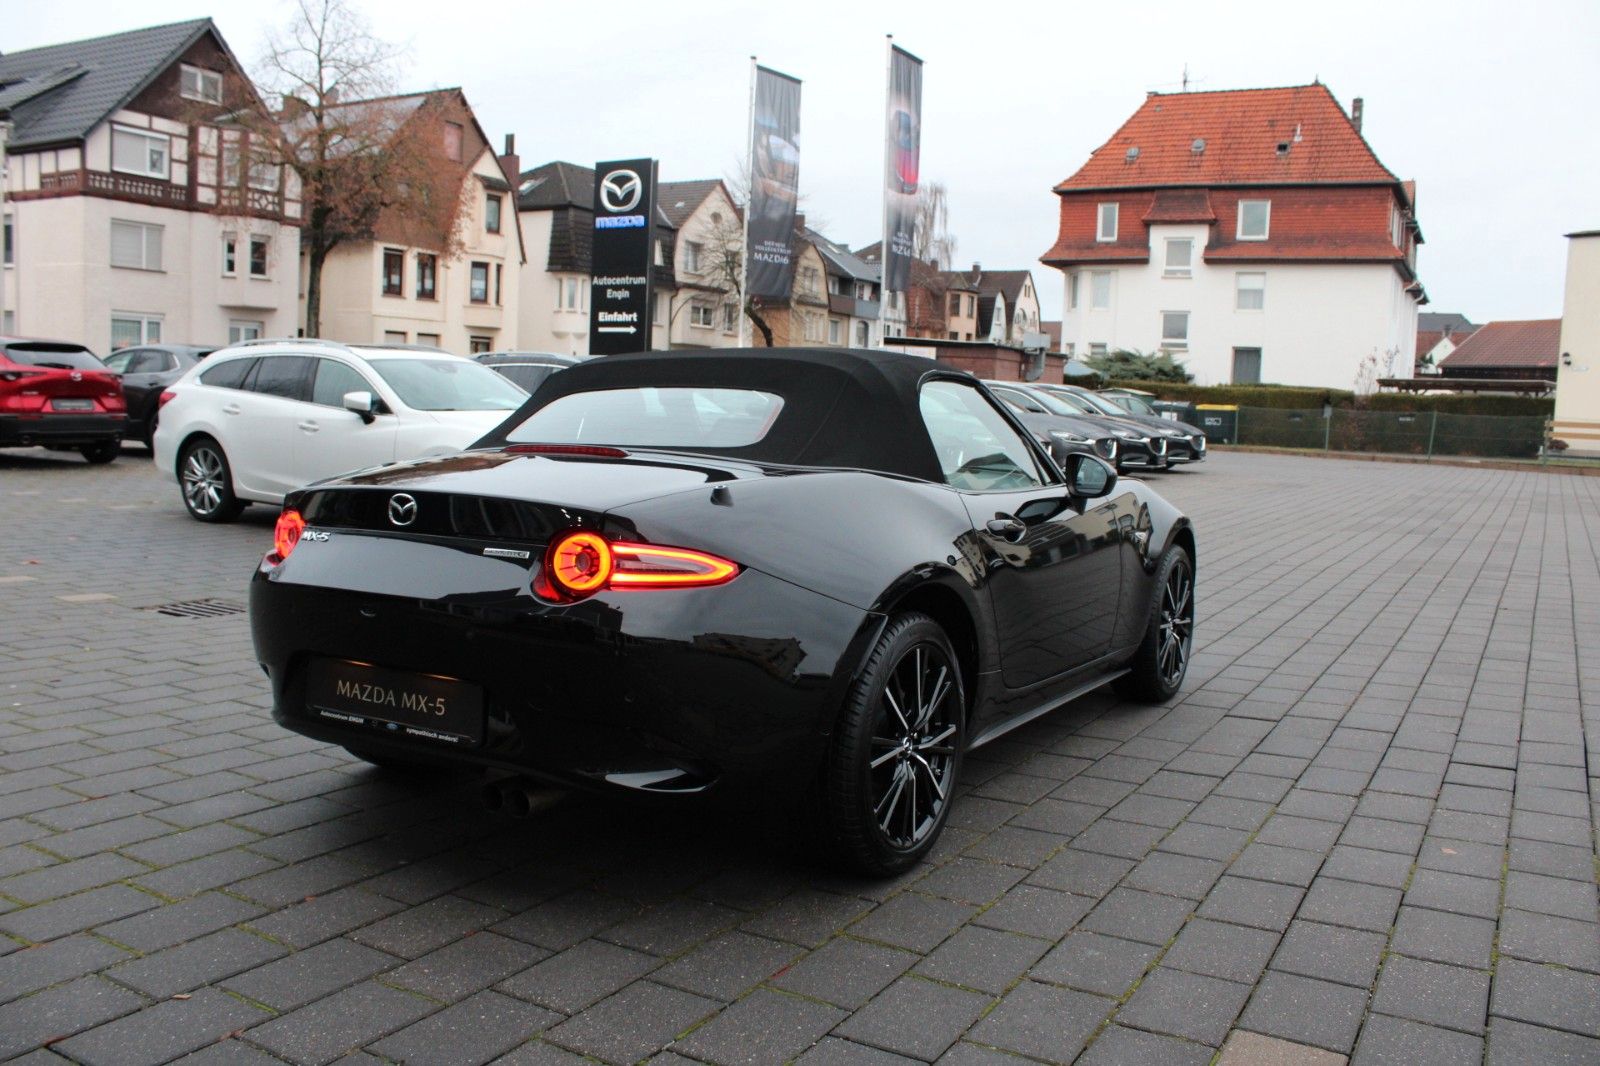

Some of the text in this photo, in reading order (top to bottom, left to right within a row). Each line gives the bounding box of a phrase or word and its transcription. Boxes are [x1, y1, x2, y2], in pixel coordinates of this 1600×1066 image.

[592, 275, 646, 286] Autocentrum
[606, 288, 630, 301] Engin
[598, 311, 638, 322] Einfahrt
[302, 530, 331, 542] MX-5
[336, 679, 446, 716] MAZDA MX-5
